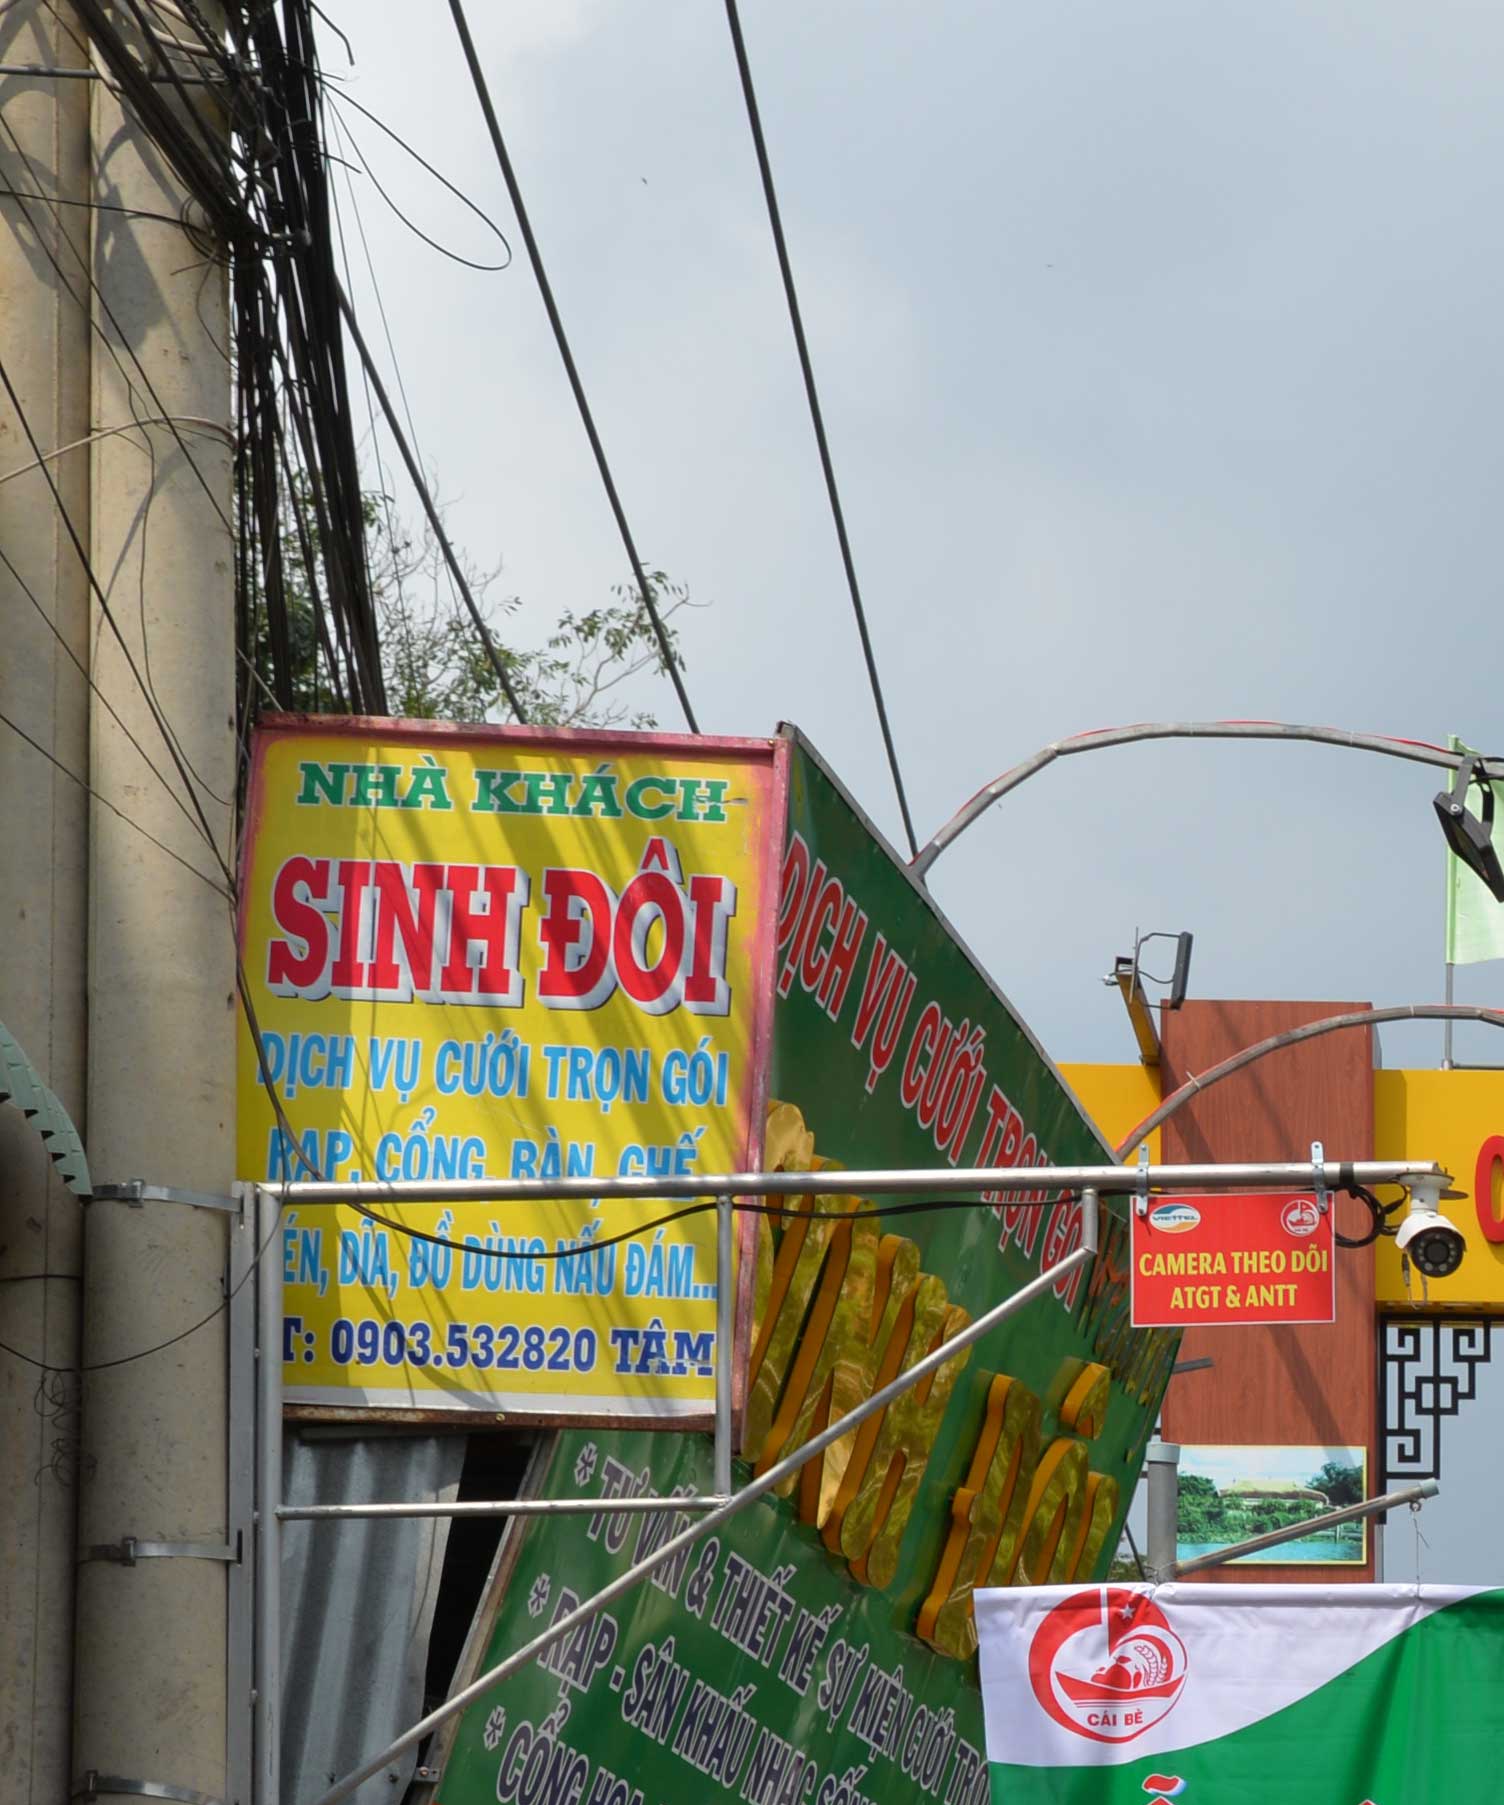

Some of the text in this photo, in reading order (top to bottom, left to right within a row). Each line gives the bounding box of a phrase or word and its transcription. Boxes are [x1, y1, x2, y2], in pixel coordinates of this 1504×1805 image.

[298, 755, 729, 822] NHÀ KHÁCH
[267, 836, 736, 1014] SINH ĐÔI
[257, 1029, 728, 1113] DỊCH VỤ CƯỚI TRỌN GÓI
[777, 831, 868, 1022] DỊCH
[851, 932, 917, 1094] VỤ
[901, 1001, 987, 1167] CƯỚI
[973, 1084, 1059, 1260] TRỌN
[338, 1220, 398, 1299] DĨA,
[409, 1211, 452, 1290] ĐỒ
[462, 1223, 545, 1295] DÙNG
[555, 1217, 615, 1296] NẤU
[1139, 1244, 1328, 1276] CAMERA THEO DÕI
[1170, 1284, 1298, 1309] ATGT & ANTT
[331, 1319, 715, 1376] 0903.532820 TÂM
[686, 1538, 957, 1805] & THIẾT KẾ SỰ KIỆN CƯỚI
[621, 1637, 679, 1743] SÂN
[671, 1684, 757, 1798] KHẤU
[1087, 1707, 1144, 1727] CÁI BÈ
